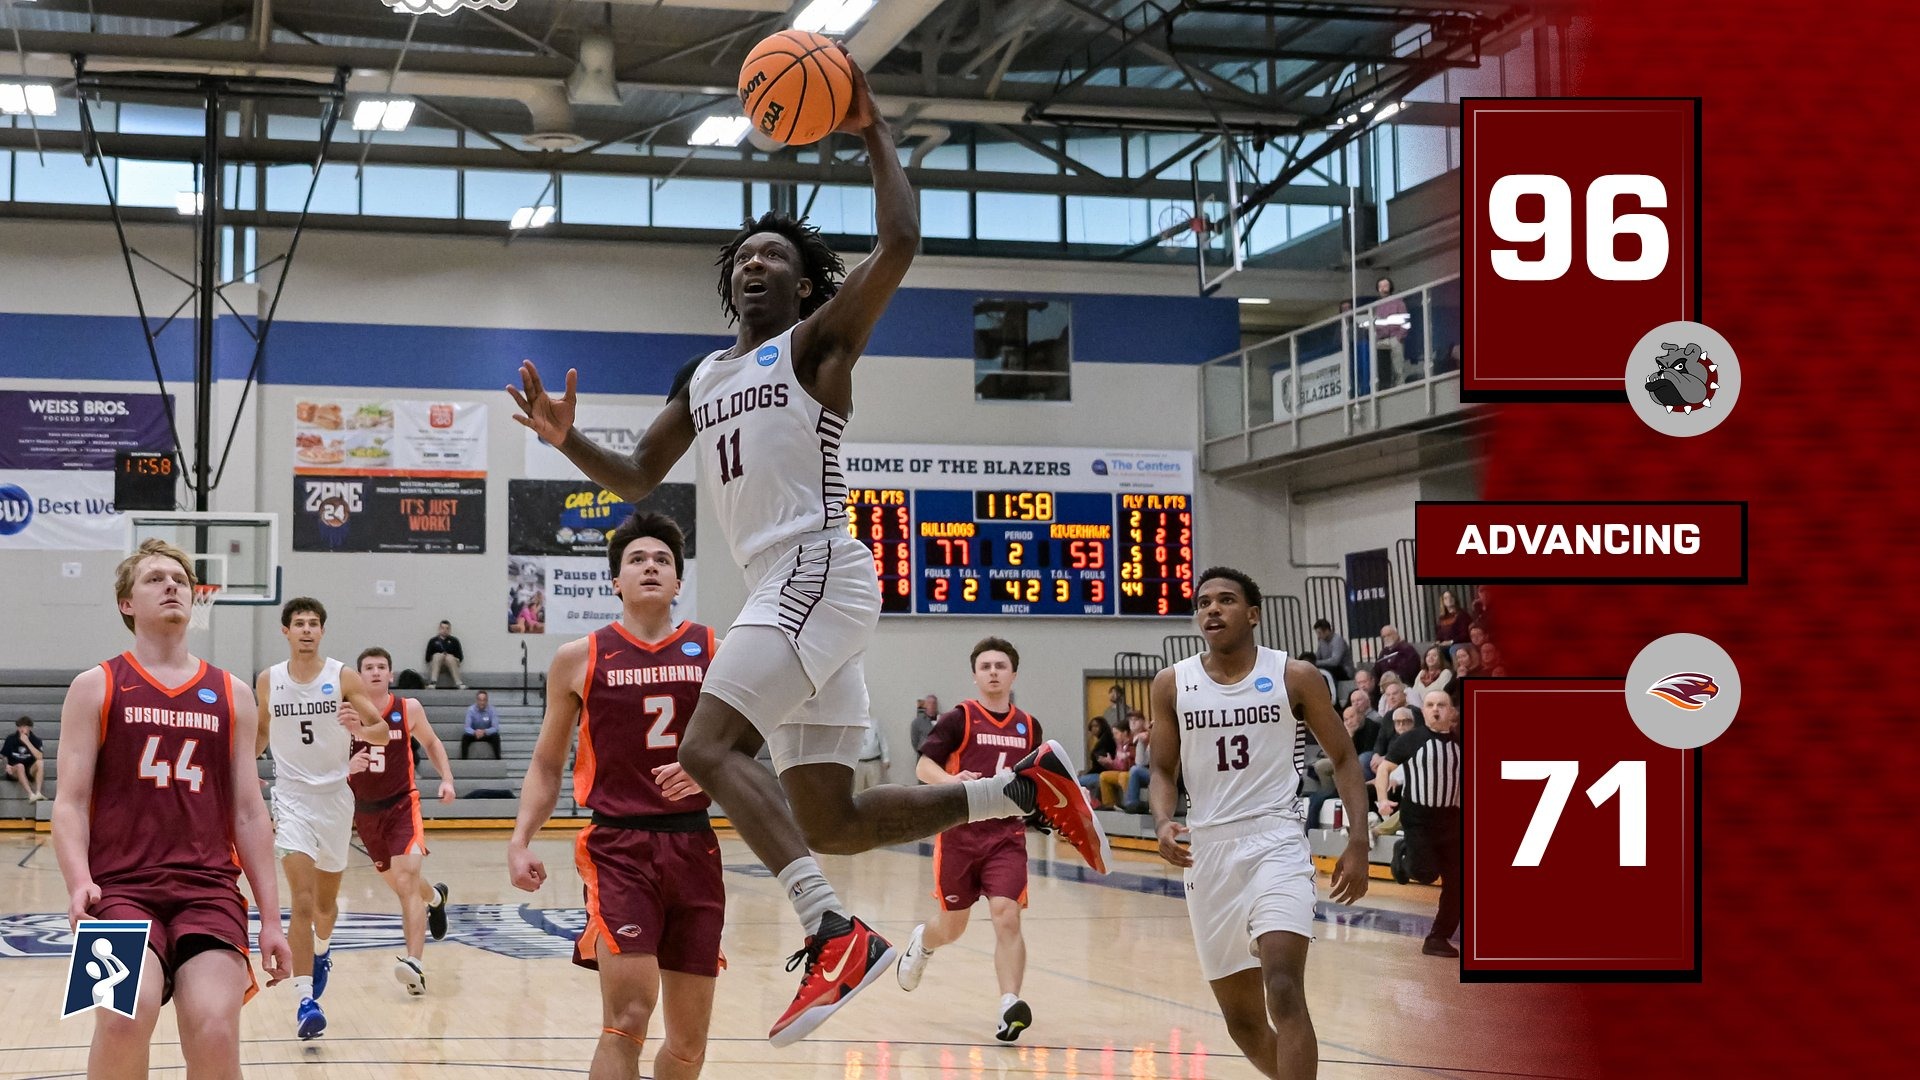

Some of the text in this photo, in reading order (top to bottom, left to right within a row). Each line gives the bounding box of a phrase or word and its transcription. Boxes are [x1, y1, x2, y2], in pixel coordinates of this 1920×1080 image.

[30, 400, 130, 416] WEISS BROS.
[692, 384, 789, 433] ULLDOGS
[717, 428, 744, 486] 11
[126, 458, 171, 475] 11:58
[847, 458, 1071, 476] HOME OF THE BLAZERS
[1111, 460, 1181, 472] The Centers
[306, 481, 363, 513] ZONE
[565, 491, 594, 509] CAR
[846, 490, 904, 505] LY FL PTS
[1148, 495, 1162, 509] FL
[1164, 495, 1186, 509] PTS
[39, 498, 82, 515] Best
[324, 504, 346, 522] 24
[400, 499, 458, 516] IT'S JUST
[872, 506, 883, 523] 2
[897, 506, 908, 523] 5
[987, 493, 1053, 520] 11:58
[409, 515, 450, 531] WORK!
[1130, 511, 1191, 527] 2 1 4
[872, 523, 883, 540] 0
[898, 524, 909, 540] 7
[921, 522, 975, 537] BULLDOGS
[1005, 531, 1033, 540] PERIOD
[1050, 523, 1111, 540] RIVERHAWK
[1130, 528, 1191, 544] 4 2 2
[897, 542, 909, 559] 6
[936, 539, 970, 566] 77
[1008, 542, 1024, 566] 2
[1070, 541, 1105, 569] 53
[1131, 545, 1191, 562] 5 0 9
[554, 569, 597, 580] Pause
[897, 559, 909, 577] 8
[925, 569, 1106, 579] FOULS T.O.L. PLAYER FOUL T.O.L. FOULS
[1121, 562, 1191, 580] 23 1 15
[554, 584, 594, 598] Enjoy
[898, 578, 909, 596] 8
[934, 578, 949, 601] 2
[963, 578, 978, 602] 2
[1056, 579, 1070, 603] 3
[1091, 579, 1105, 602] 3
[1121, 581, 1143, 597] 44
[1181, 580, 1192, 598] 5
[567, 610, 580, 619] Go
[929, 603, 1103, 614] WON MATCH WON
[1158, 597, 1168, 615] 3
[607, 665, 703, 687] SUSQUEHANNA
[273, 700, 337, 717] BULLDOGS
[124, 706, 219, 733] SUSQUEHANNA
[643, 694, 678, 749] 2
[1184, 705, 1281, 731] BULLDOGS
[300, 720, 315, 745] 5
[1216, 734, 1250, 772] 13
[137, 735, 204, 793] 44
